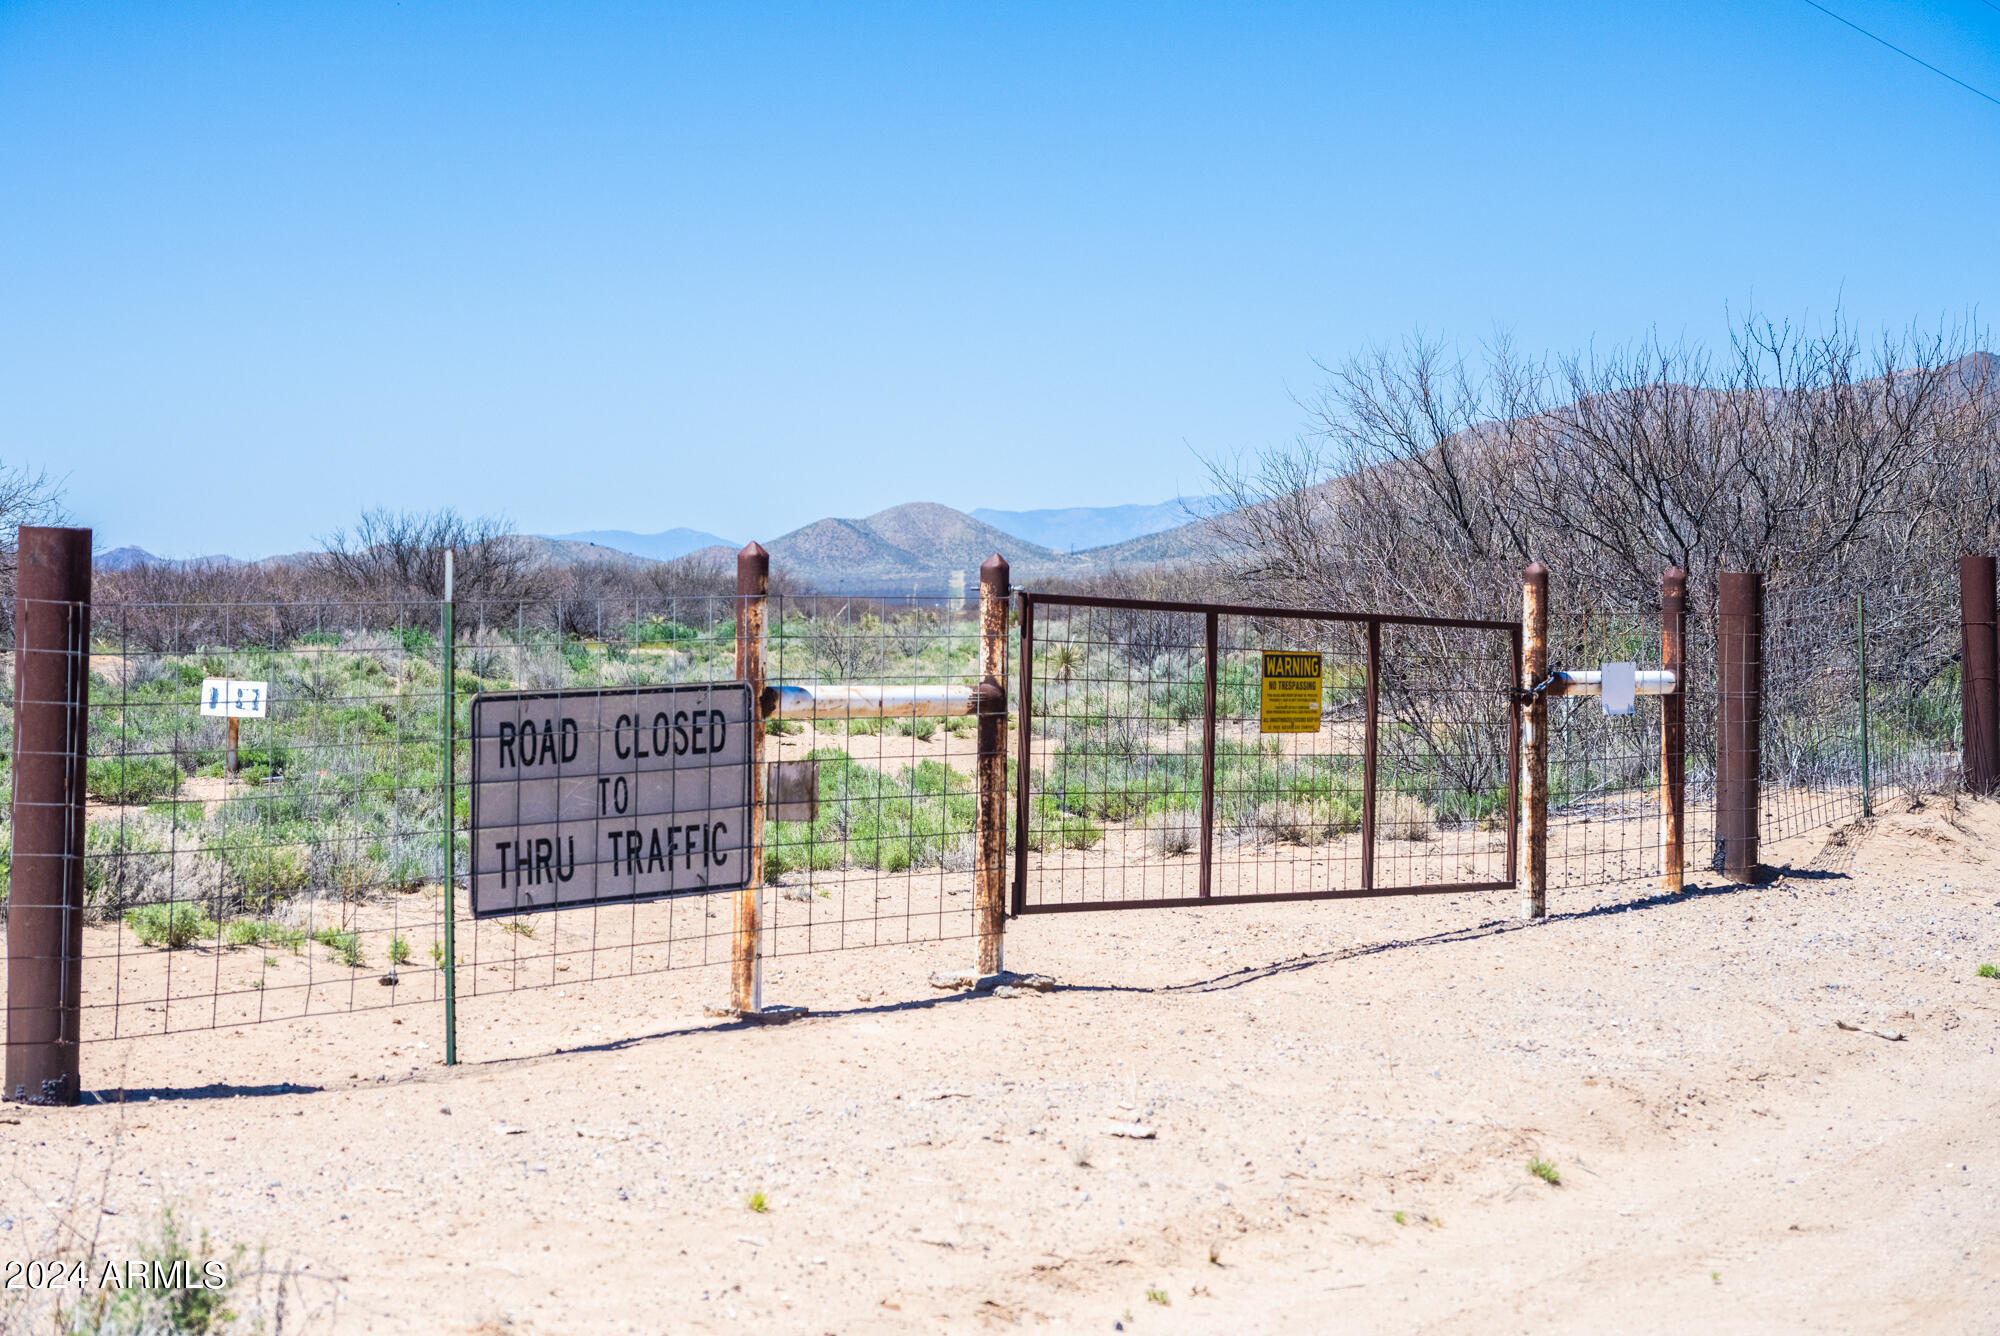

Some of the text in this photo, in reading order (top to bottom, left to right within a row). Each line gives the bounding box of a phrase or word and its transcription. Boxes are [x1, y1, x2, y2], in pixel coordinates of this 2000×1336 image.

[1266, 656, 1319, 677] WARNING
[1269, 681, 1316, 690] NO TRESPASSING
[499, 709, 727, 768] ROAD CLOSED
[599, 775, 629, 816] TO
[496, 821, 728, 889] THRU TRAFFIC
